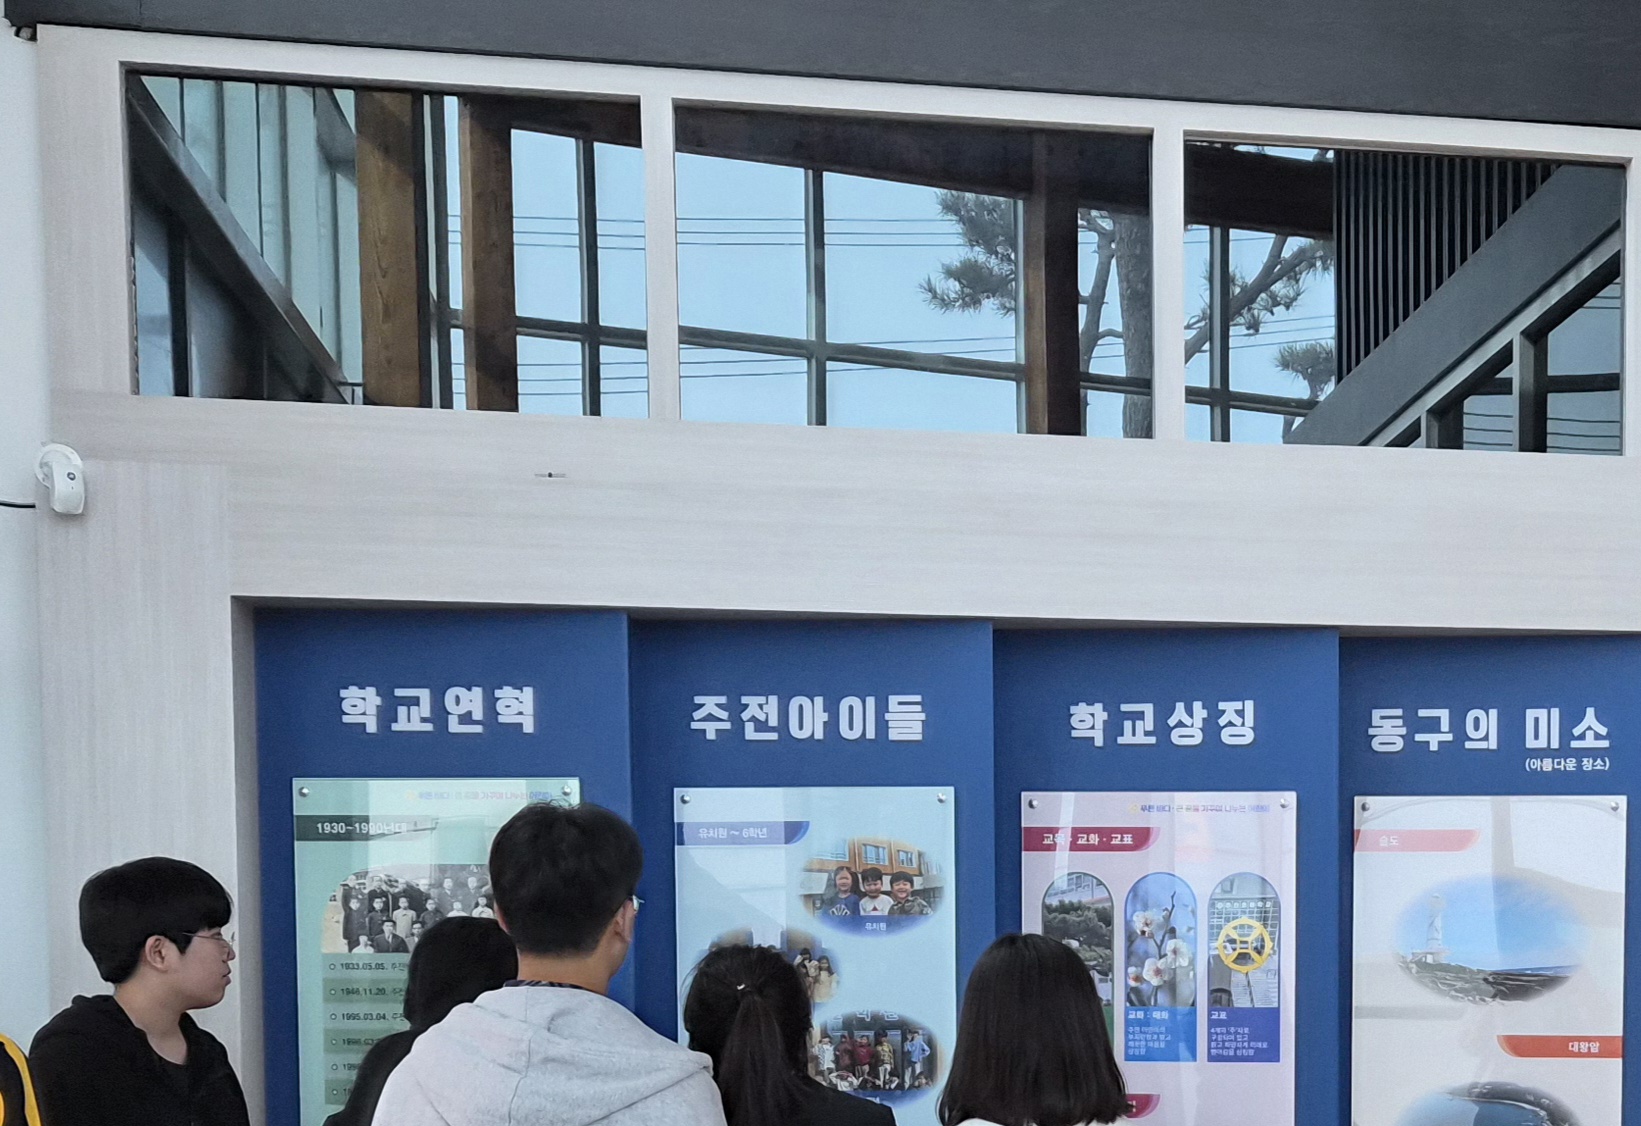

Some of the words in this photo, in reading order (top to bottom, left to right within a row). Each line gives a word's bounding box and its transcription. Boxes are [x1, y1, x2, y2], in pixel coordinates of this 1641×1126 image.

[340, 686, 534, 733] 학교연혁
[690, 695, 926, 741] 주전아이들
[1070, 699, 1255, 747] 학교상징
[1368, 708, 1498, 752] 동구의
[1525, 707, 1610, 749] 미소
[1525, 757, 1577, 772] (아름다운
[1581, 757, 1610, 771] 장소)
[698, 827, 728, 839] 유치원
[742, 827, 768, 839] 6학년
[1076, 834, 1100, 846] 교화
[1110, 834, 1134, 845] 교표
[1568, 1041, 1600, 1053] 대왕암
